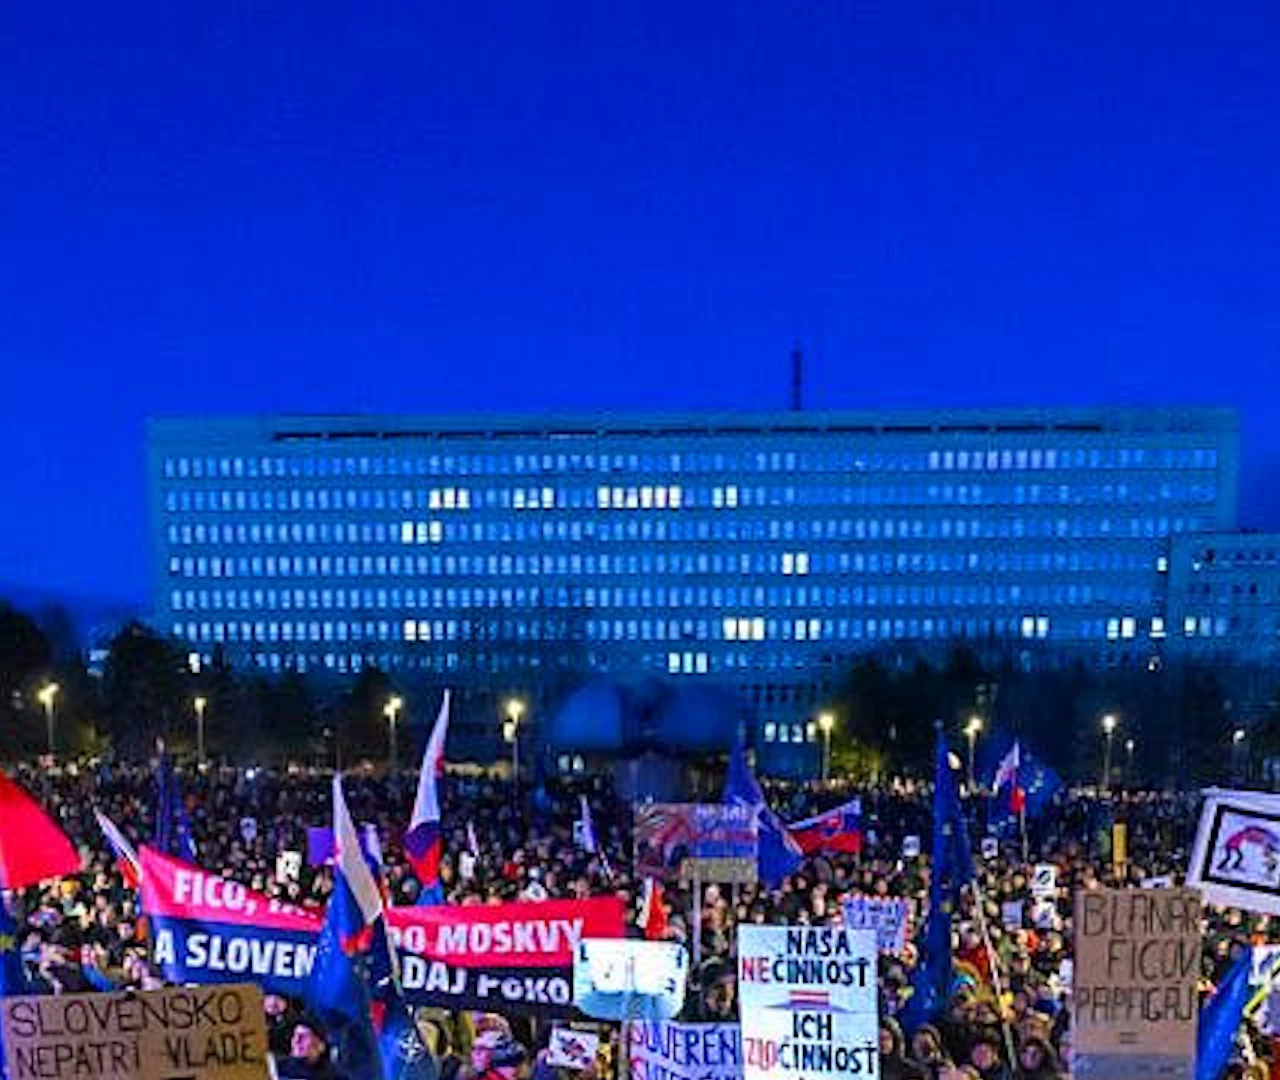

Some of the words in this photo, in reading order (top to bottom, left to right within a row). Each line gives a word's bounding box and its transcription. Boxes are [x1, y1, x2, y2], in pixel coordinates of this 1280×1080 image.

[172, 868, 258, 916] FICO,
[154, 929, 176, 965] A
[435, 917, 584, 955] MOSKVY
[402, 956, 468, 995] DAJ
[10, 991, 243, 1038] SLOVENSKO
[793, 1014, 833, 1041] ICH
